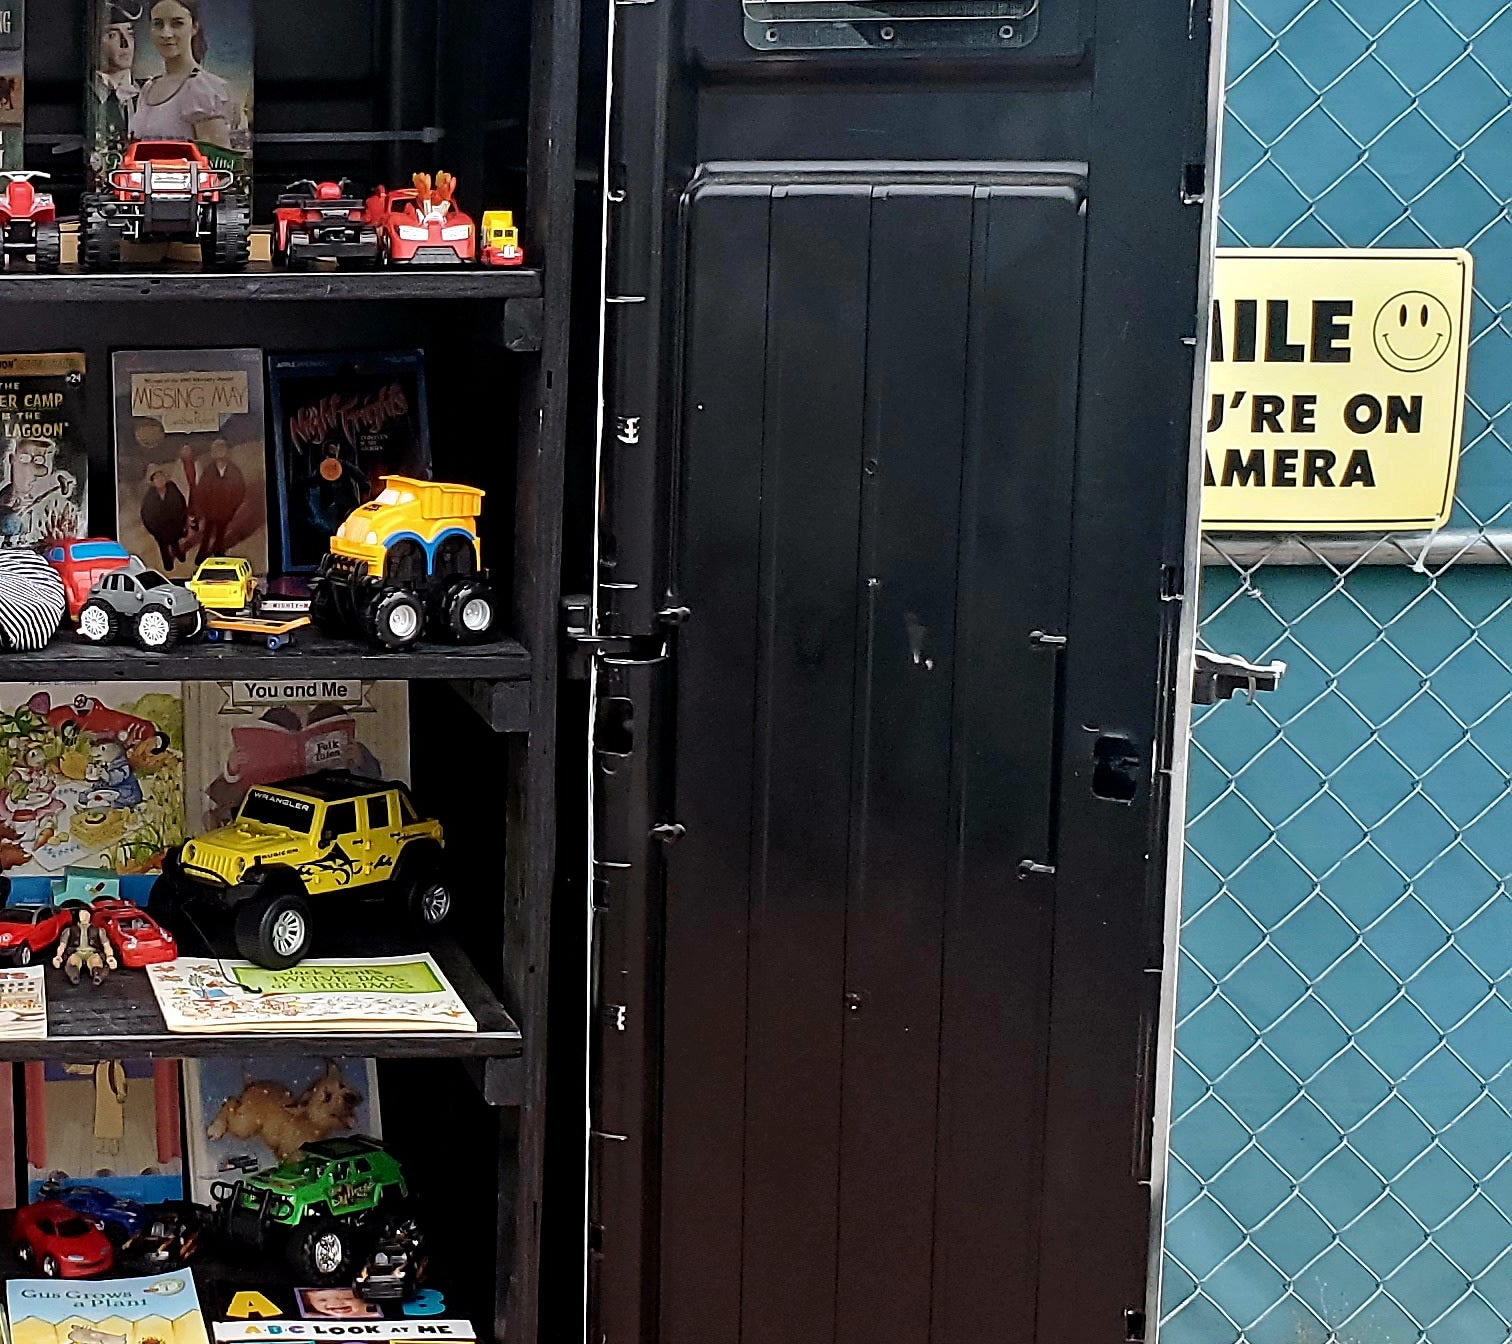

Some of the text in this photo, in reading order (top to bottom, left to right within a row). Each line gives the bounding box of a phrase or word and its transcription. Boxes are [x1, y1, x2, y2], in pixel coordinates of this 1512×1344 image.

[1210, 299, 1353, 362] ILE
[24, 392, 64, 408] CAMP
[133, 384, 245, 410] MISSING MAY
[16, 412, 41, 420] THE
[1344, 393, 1423, 434] ON
[4, 422, 64, 438] LAGOON
[1204, 449, 1376, 487] MERA
[245, 682, 348, 698] You and Me
[317, 740, 339, 752] Folk
[254, 791, 309, 812] WRANGLER
[300, 981, 414, 990] CHRISTMAS
[21, 1289, 132, 1299] Gus Grows
[73, 1298, 147, 1308] a Plant
[226, 1289, 446, 1318] A B
[314, 1325, 380, 1335] LOOK
[418, 1325, 454, 1335] ME
